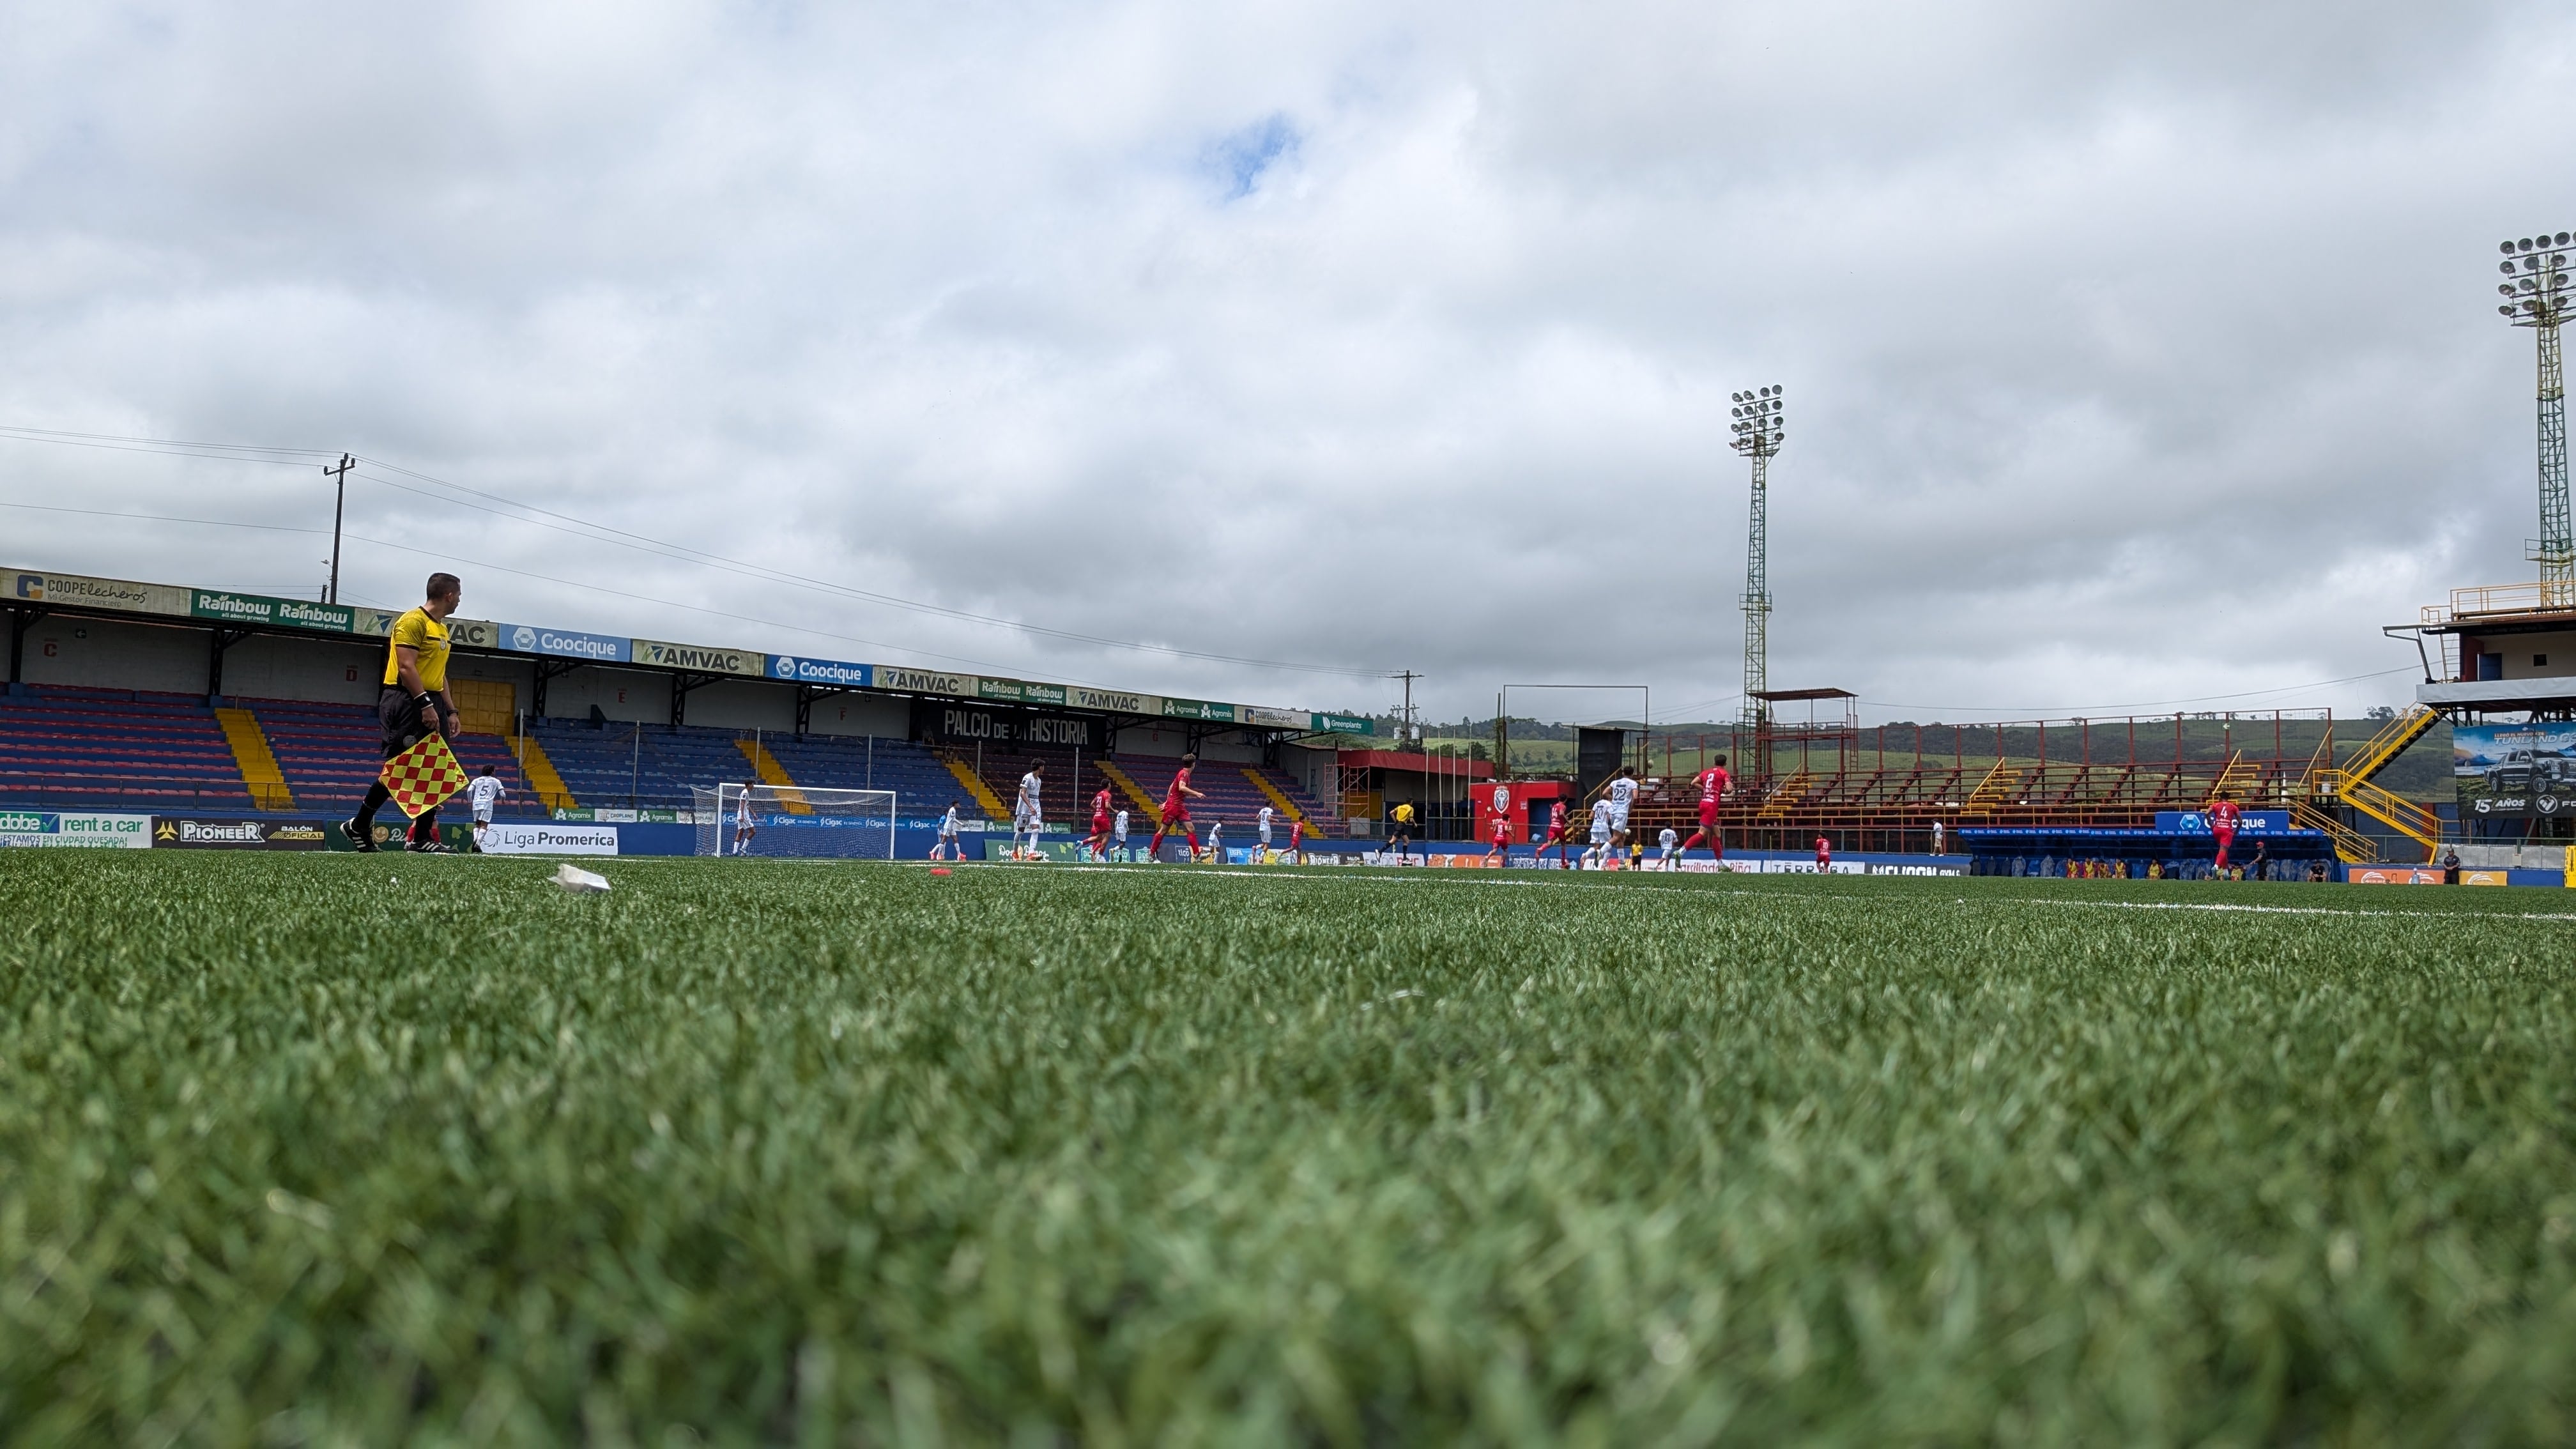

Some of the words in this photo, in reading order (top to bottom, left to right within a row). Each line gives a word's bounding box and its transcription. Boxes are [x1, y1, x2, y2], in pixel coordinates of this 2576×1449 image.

[47, 579, 148, 604] COOPElecheros
[59, 595, 83, 603] Gestor
[84, 597, 122, 608] Financiero
[199, 594, 271, 615] Rainbow
[279, 603, 348, 624] Rainbow
[324, 623, 346, 631] growing
[43, 643, 57, 657] C
[541, 633, 617, 657] Coocique
[663, 648, 740, 671] AMVAC
[799, 662, 862, 684] Coocique
[896, 673, 959, 693] AMVAC
[982, 681, 1020, 695] Rainbow
[1026, 686, 1063, 699] Rainbow
[1087, 694, 1139, 711] AMVAC
[1176, 705, 1198, 714] Agromix
[1212, 710, 1232, 718] Agromix
[944, 709, 990, 737] PALCO
[993, 723, 1009, 739] DE
[1030, 717, 1088, 745] HISTORIA
[1331, 719, 1361, 729] Greenplants
[1705, 773, 1714, 788] 2
[479, 785, 489, 797] 5
[1614, 788, 1627, 801] 22
[2220, 806, 2228, 818] 4
[2474, 799, 2493, 813] 15
[2496, 798, 2526, 808] AÑOS
[65, 818, 98, 831] rent
[102, 820, 112, 832] a
[116, 820, 144, 832] car
[778, 816, 796, 826] Cigac
[825, 817, 843, 827] Cigac
[870, 819, 886, 827] Cigac
[914, 821, 930, 829] Cigac
[55, 836, 86, 844] CIUDAD
[504, 831, 535, 848] Liga
[537, 831, 615, 847] Promerica
